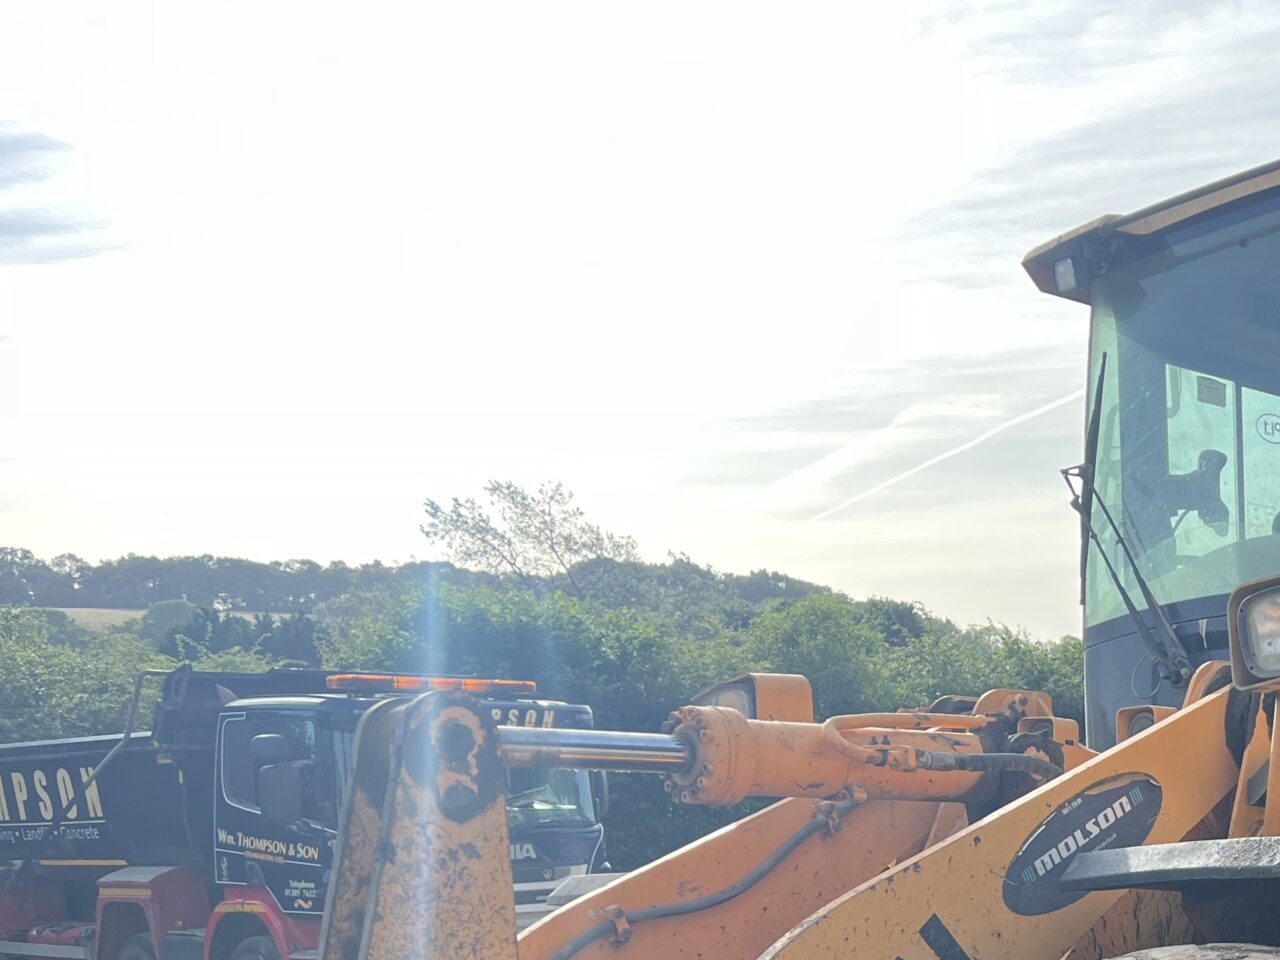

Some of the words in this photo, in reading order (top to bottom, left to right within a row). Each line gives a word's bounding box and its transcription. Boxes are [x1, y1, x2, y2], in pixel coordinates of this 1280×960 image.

[236, 832, 287, 855] THOMPSON
[288, 843, 296, 857] &
[296, 842, 319, 860] SON
